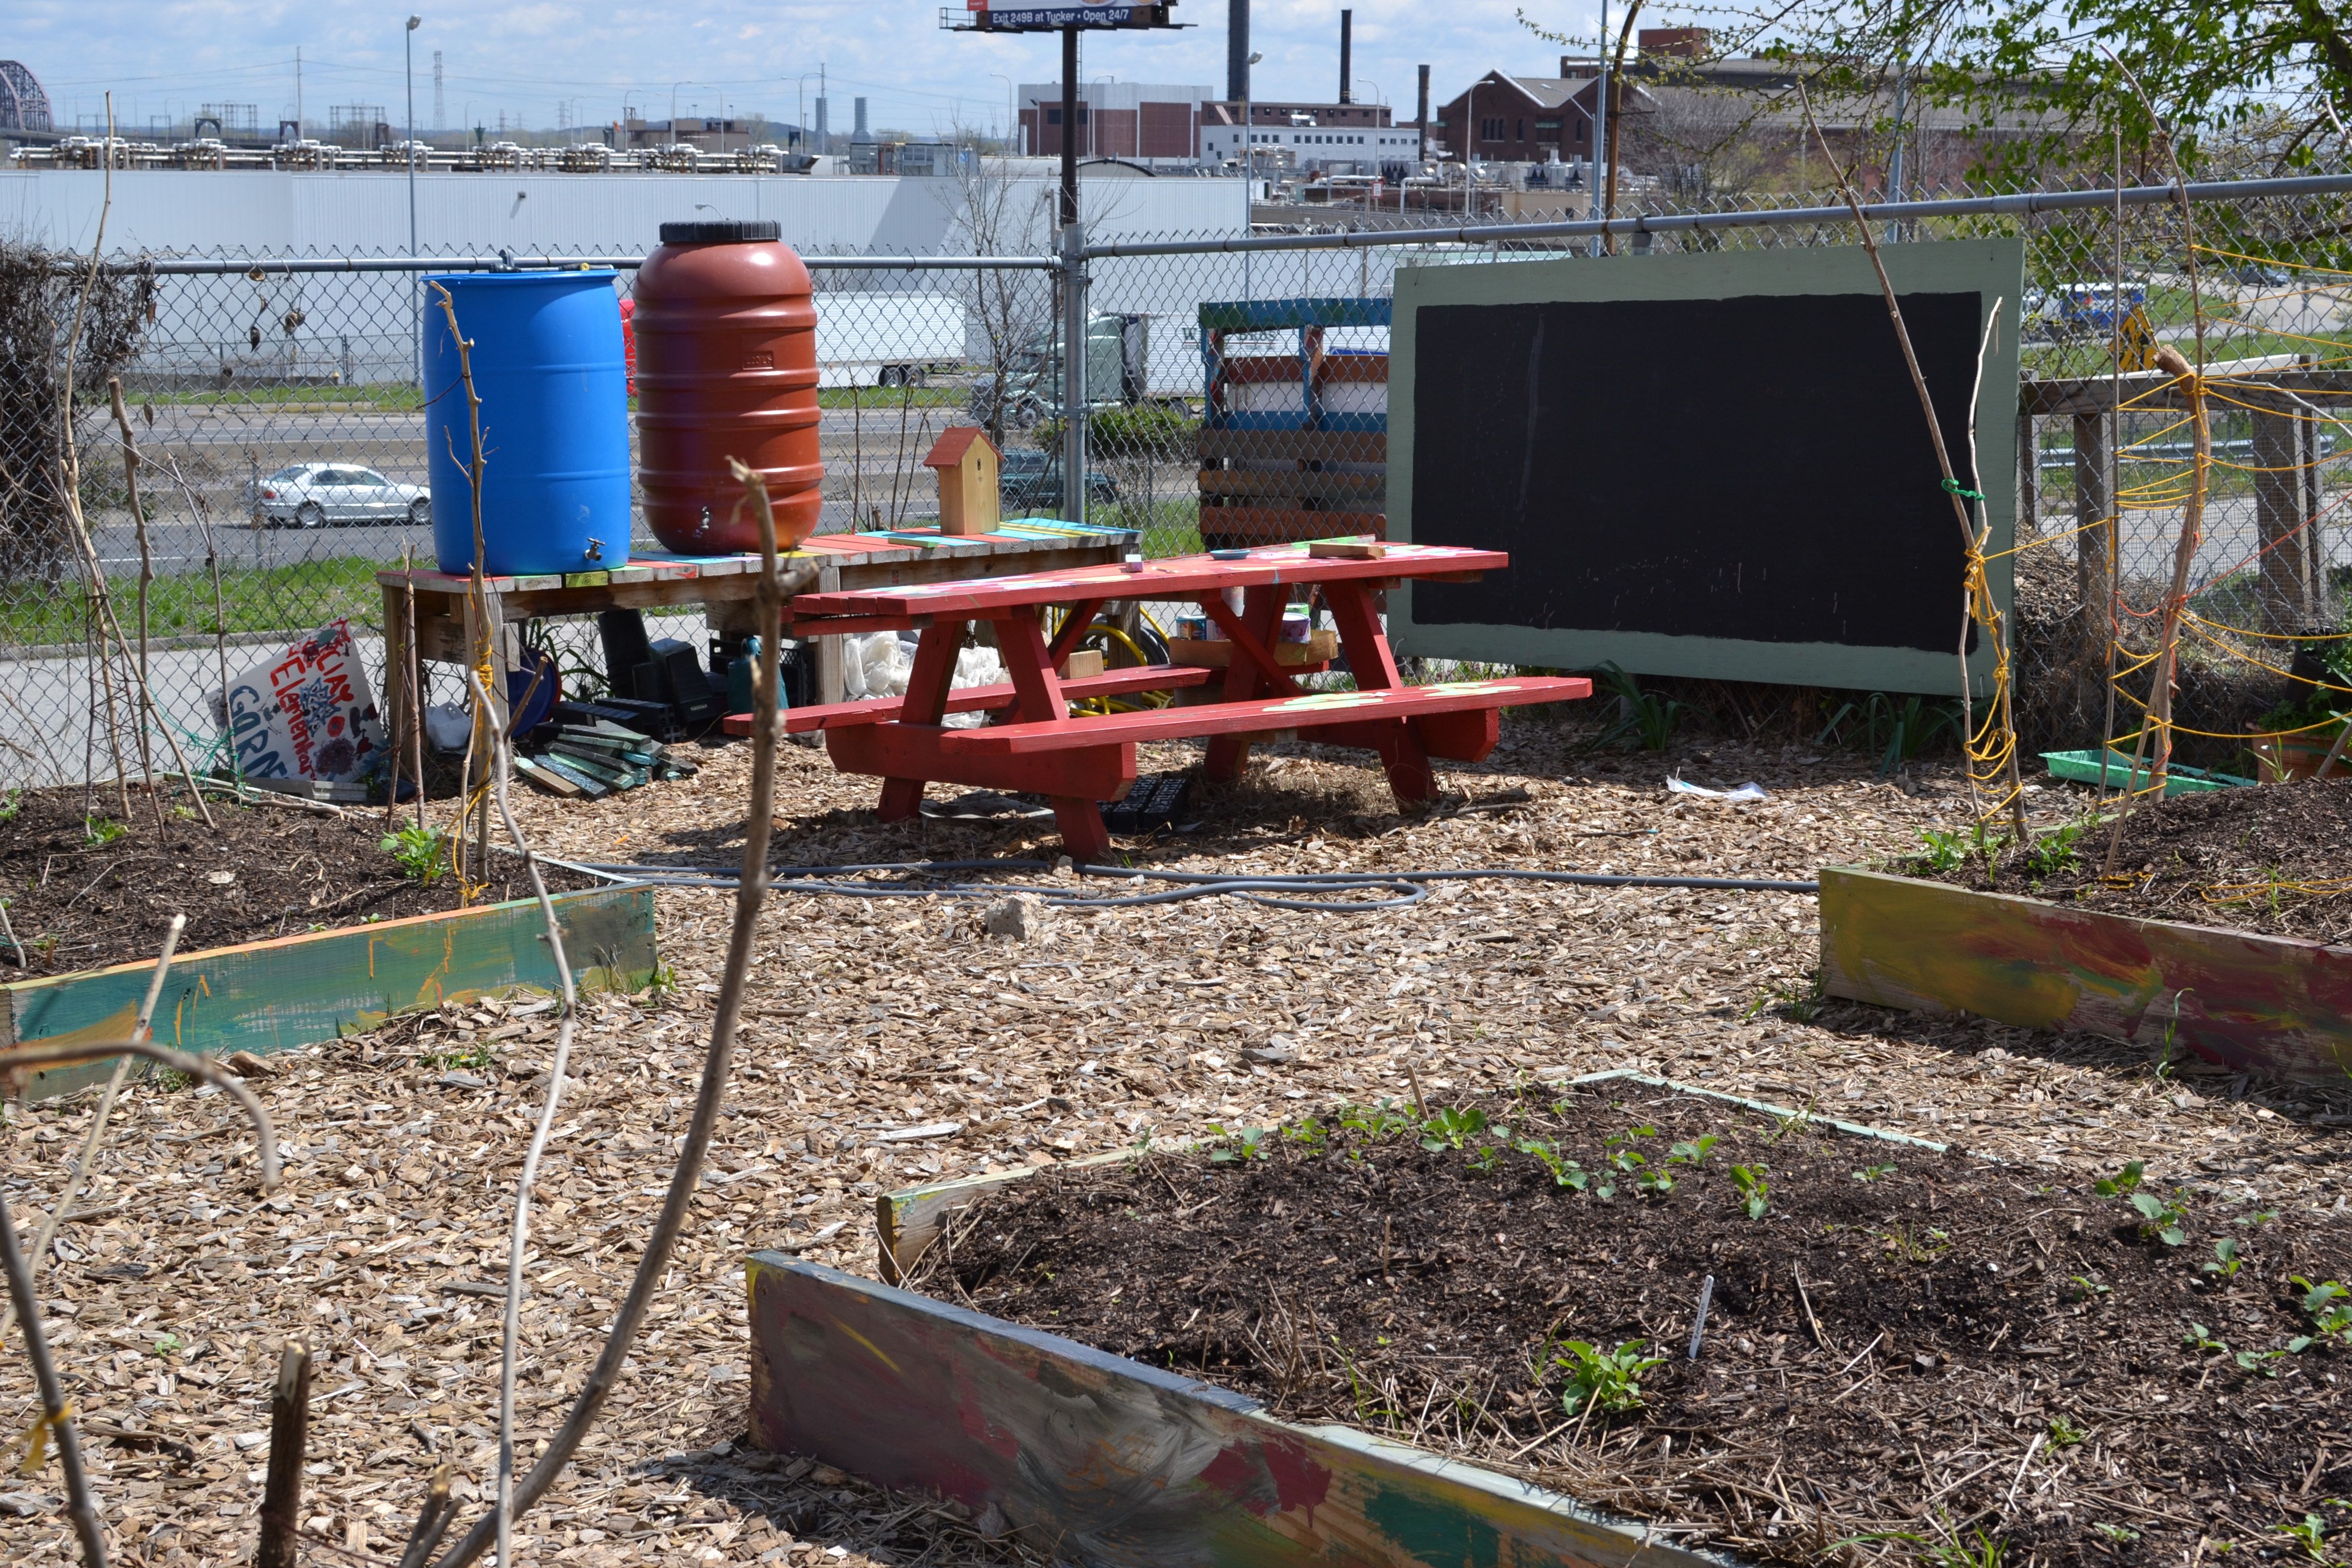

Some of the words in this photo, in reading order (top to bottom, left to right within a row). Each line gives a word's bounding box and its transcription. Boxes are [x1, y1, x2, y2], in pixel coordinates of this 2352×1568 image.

[993, 13, 1009, 23] Exit
[1011, 12, 1033, 23] 249B
[1035, 12, 1044, 22] at
[1046, 11, 1075, 22] Tucker
[1083, 10, 1106, 23] Open
[1108, 9, 1129, 20] 24/7
[270, 656, 317, 781] Elementar
